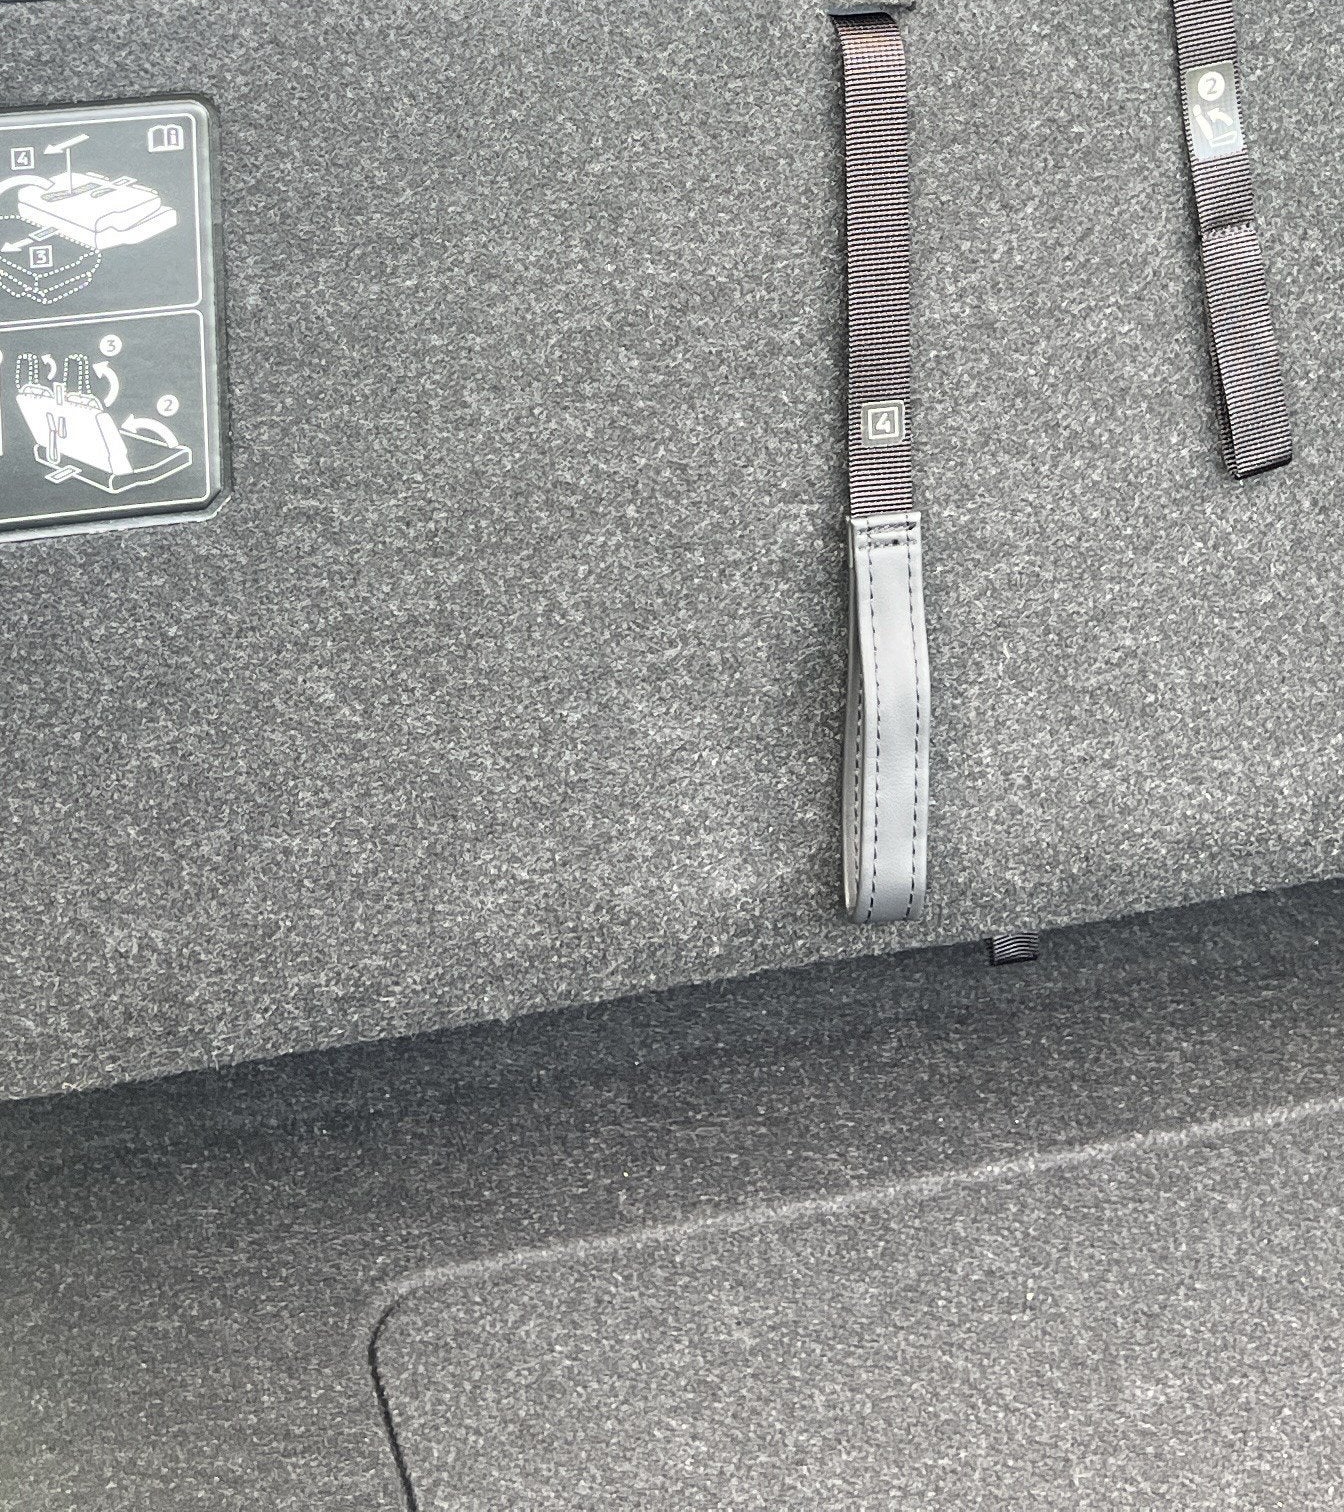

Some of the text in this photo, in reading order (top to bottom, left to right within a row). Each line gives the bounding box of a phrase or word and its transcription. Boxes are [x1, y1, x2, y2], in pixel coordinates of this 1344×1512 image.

[1205, 77, 1218, 96] 2
[17, 151, 28, 165] 4
[36, 249, 47, 264] 3
[876, 412, 891, 433] 4
